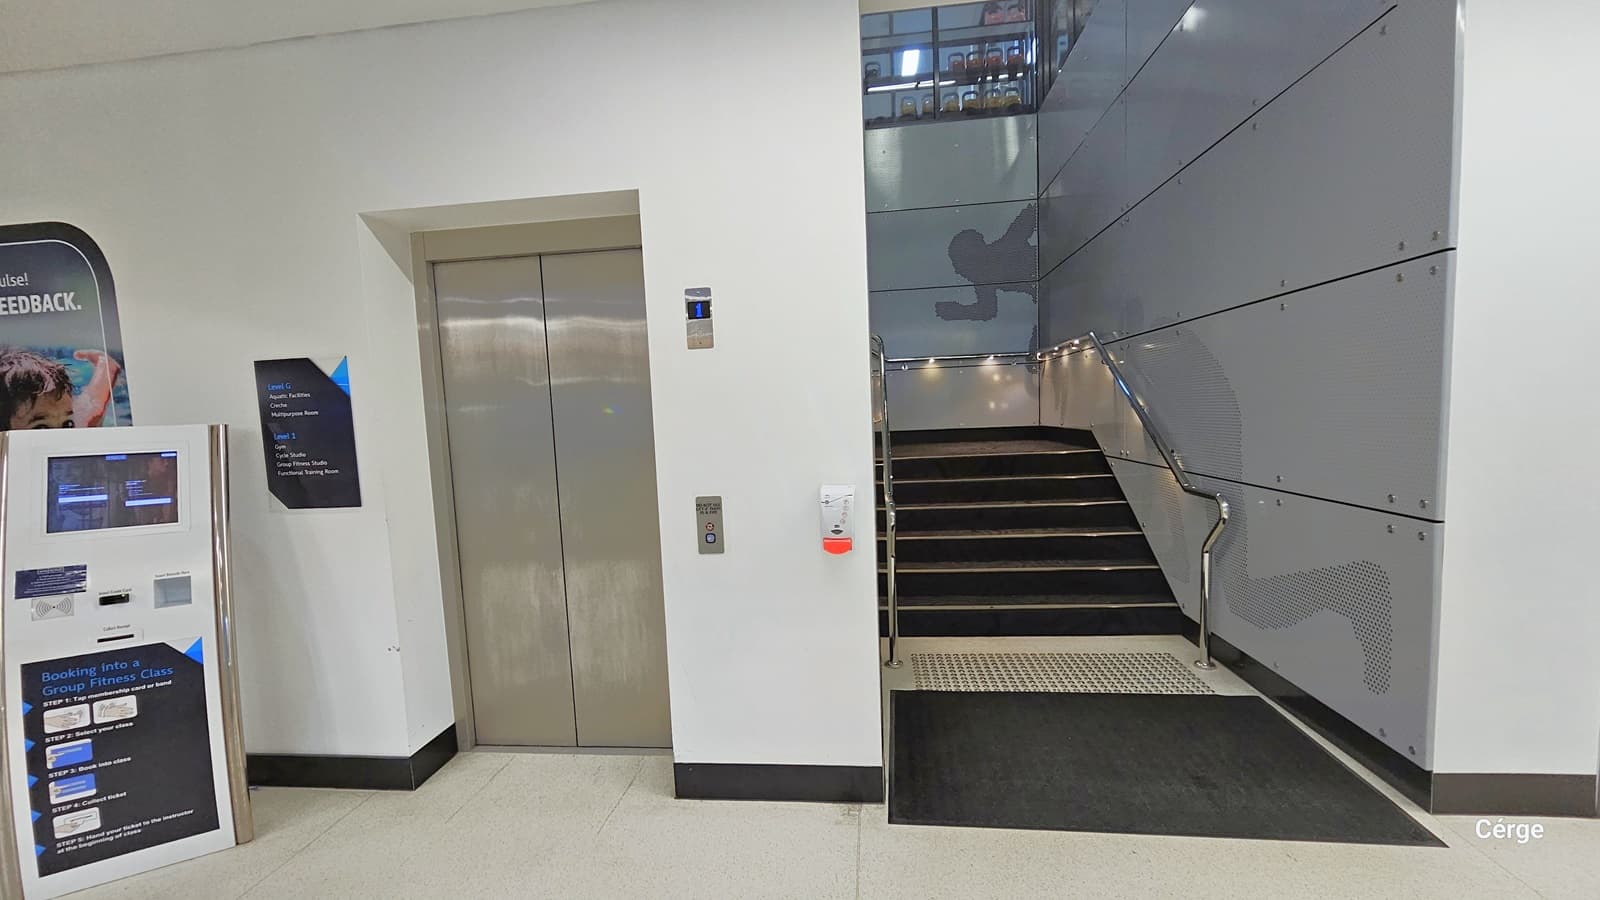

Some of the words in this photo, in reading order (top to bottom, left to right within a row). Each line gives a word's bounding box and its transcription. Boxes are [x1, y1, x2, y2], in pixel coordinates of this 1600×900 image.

[696, 303, 702, 317] 1
[268, 383, 284, 391] Level
[274, 432, 290, 440] Level
[41, 666, 97, 682] Booking
[101, 662, 128, 673] into
[42, 682, 85, 696] Group
[90, 673, 136, 688] Fitness
[140, 667, 174, 679] Class
[43, 698, 63, 708] STEP
[73, 695, 87, 703] Tap
[87, 686, 130, 699] membership
[131, 684, 146, 692] card
[155, 679, 172, 688] band
[45, 734, 66, 743] STEP
[75, 728, 97, 737] Select
[97, 725, 114, 734] your
[115, 721, 134, 729] class
[48, 769, 69, 779] STEP
[78, 764, 97, 772] Book
[98, 760, 112, 768] into
[113, 756, 132, 765] class
[52, 804, 72, 814] STEP
[81, 796, 107, 806] Collect
[107, 791, 127, 800] ticket
[56, 838, 76, 848] STEP
[86, 831, 105, 840] Hand
[106, 827, 122, 836] your
[123, 822, 142, 831] ticket
[162, 808, 194, 821] instructor
[65, 844, 78, 852] the
[78, 835, 114, 849] beginning
[123, 828, 142, 838] class
